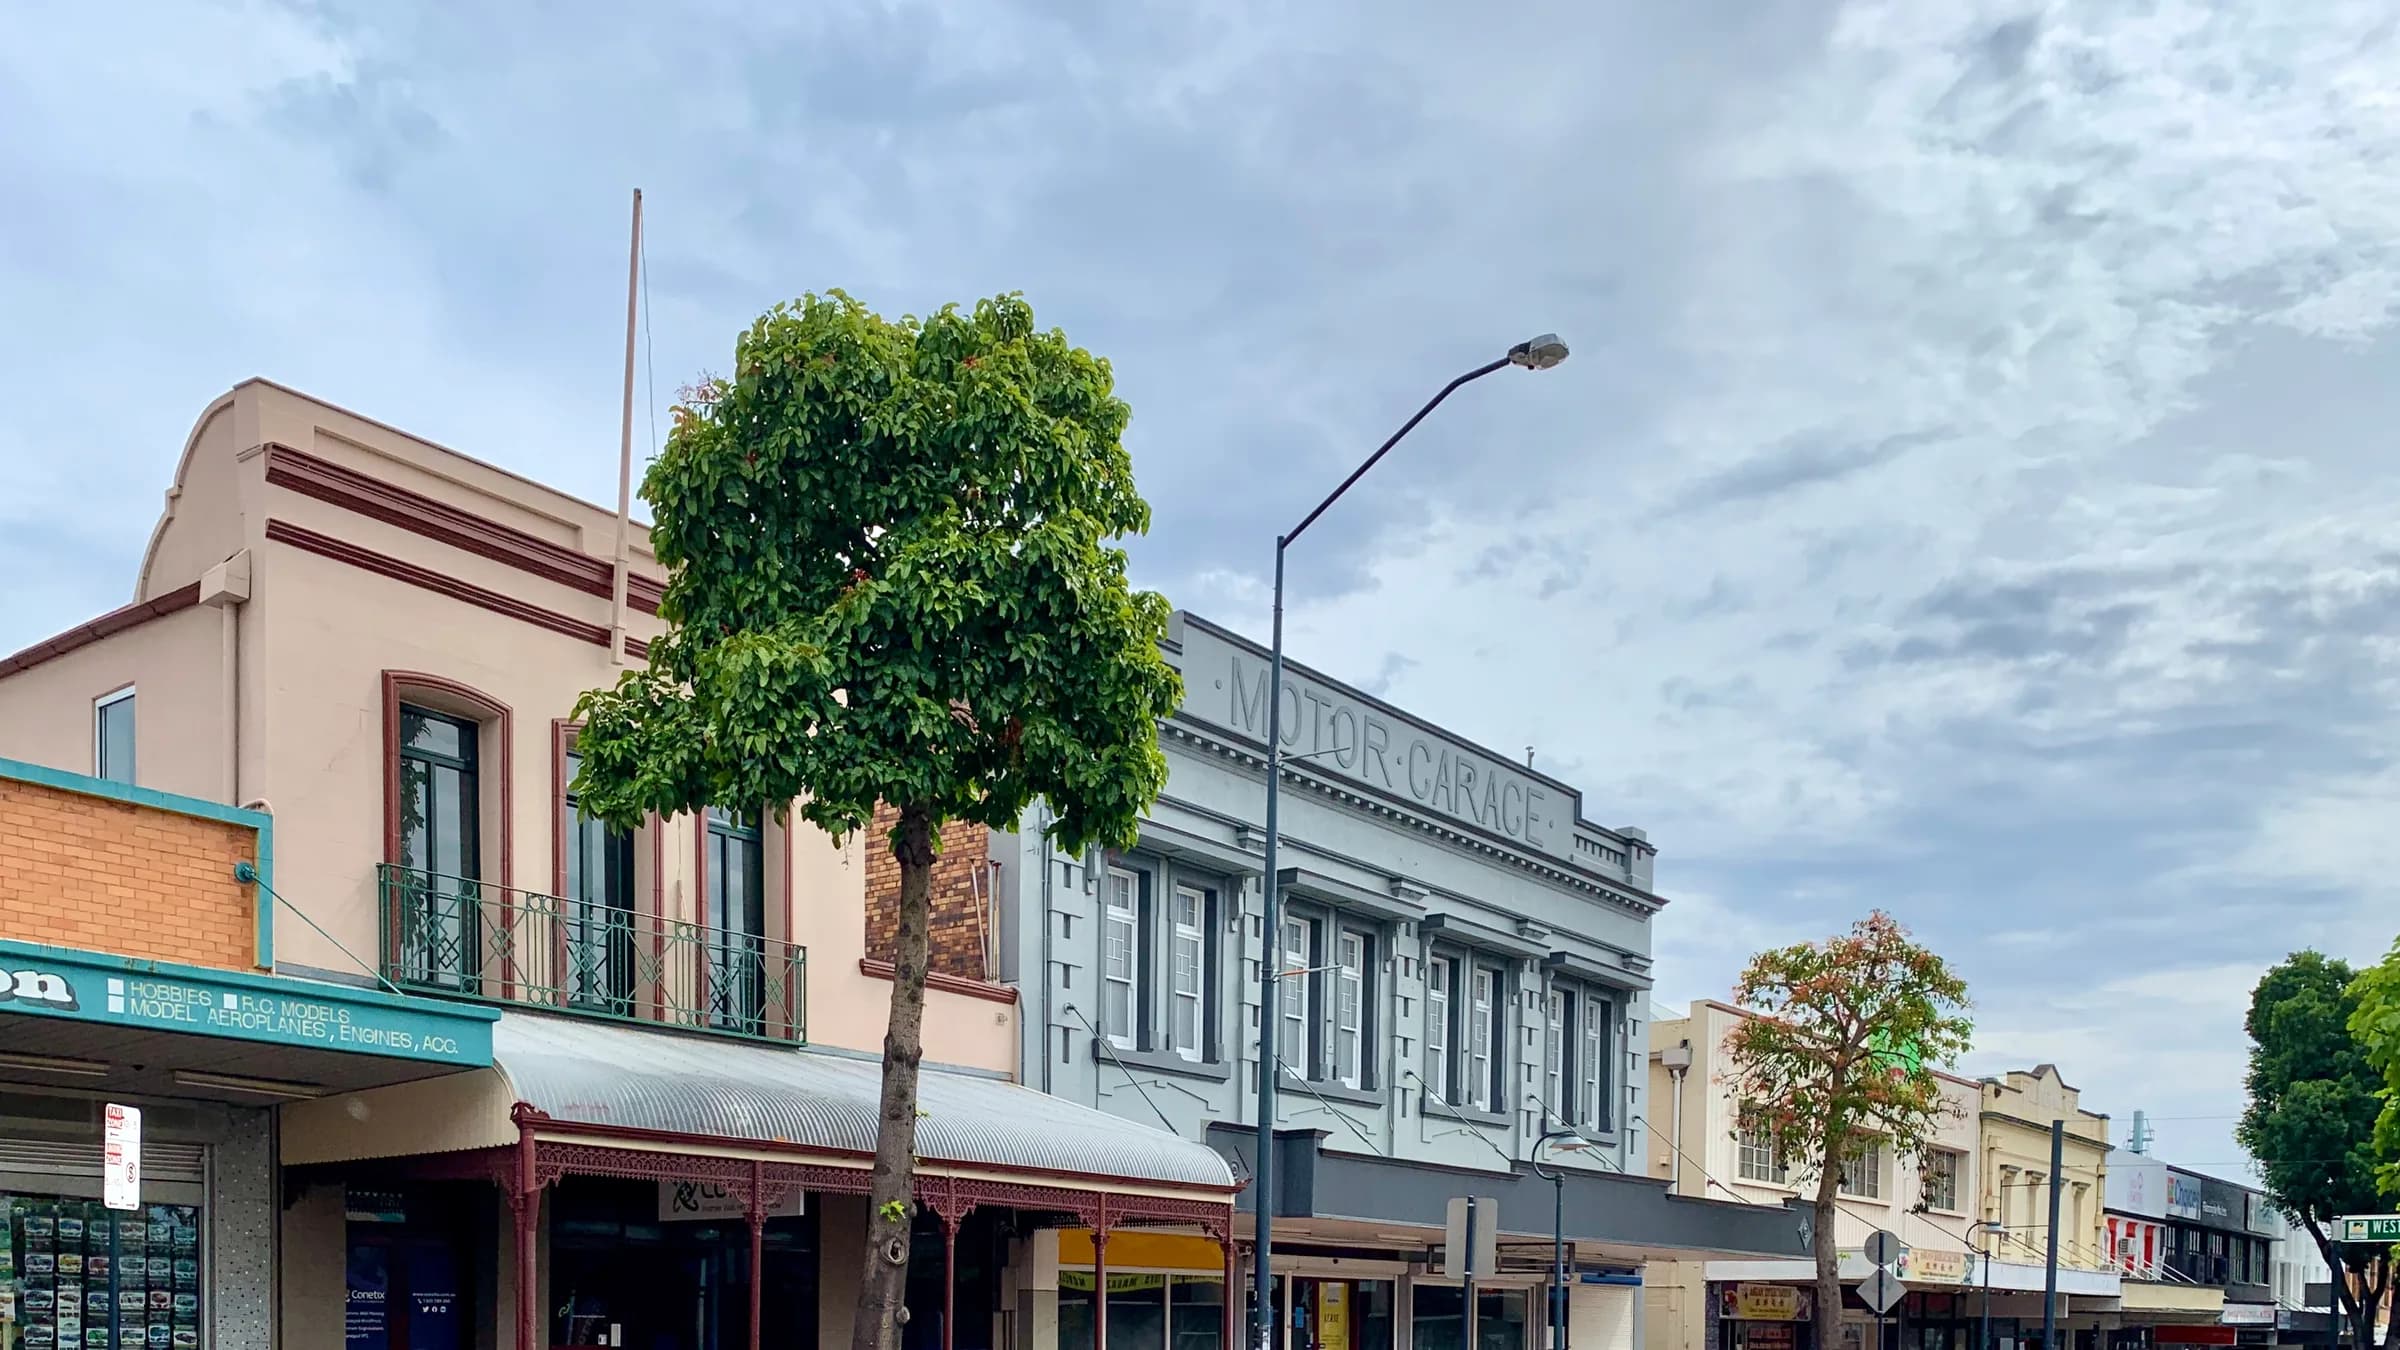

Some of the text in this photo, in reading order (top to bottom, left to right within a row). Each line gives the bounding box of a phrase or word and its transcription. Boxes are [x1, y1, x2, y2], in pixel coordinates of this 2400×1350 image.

[1231, 655, 1392, 788] MOTOR
[130, 981, 350, 1024] HOBBIES R.C. MODELS
[130, 998, 198, 1022] MODEL
[351, 1289, 385, 1300] Conetix
